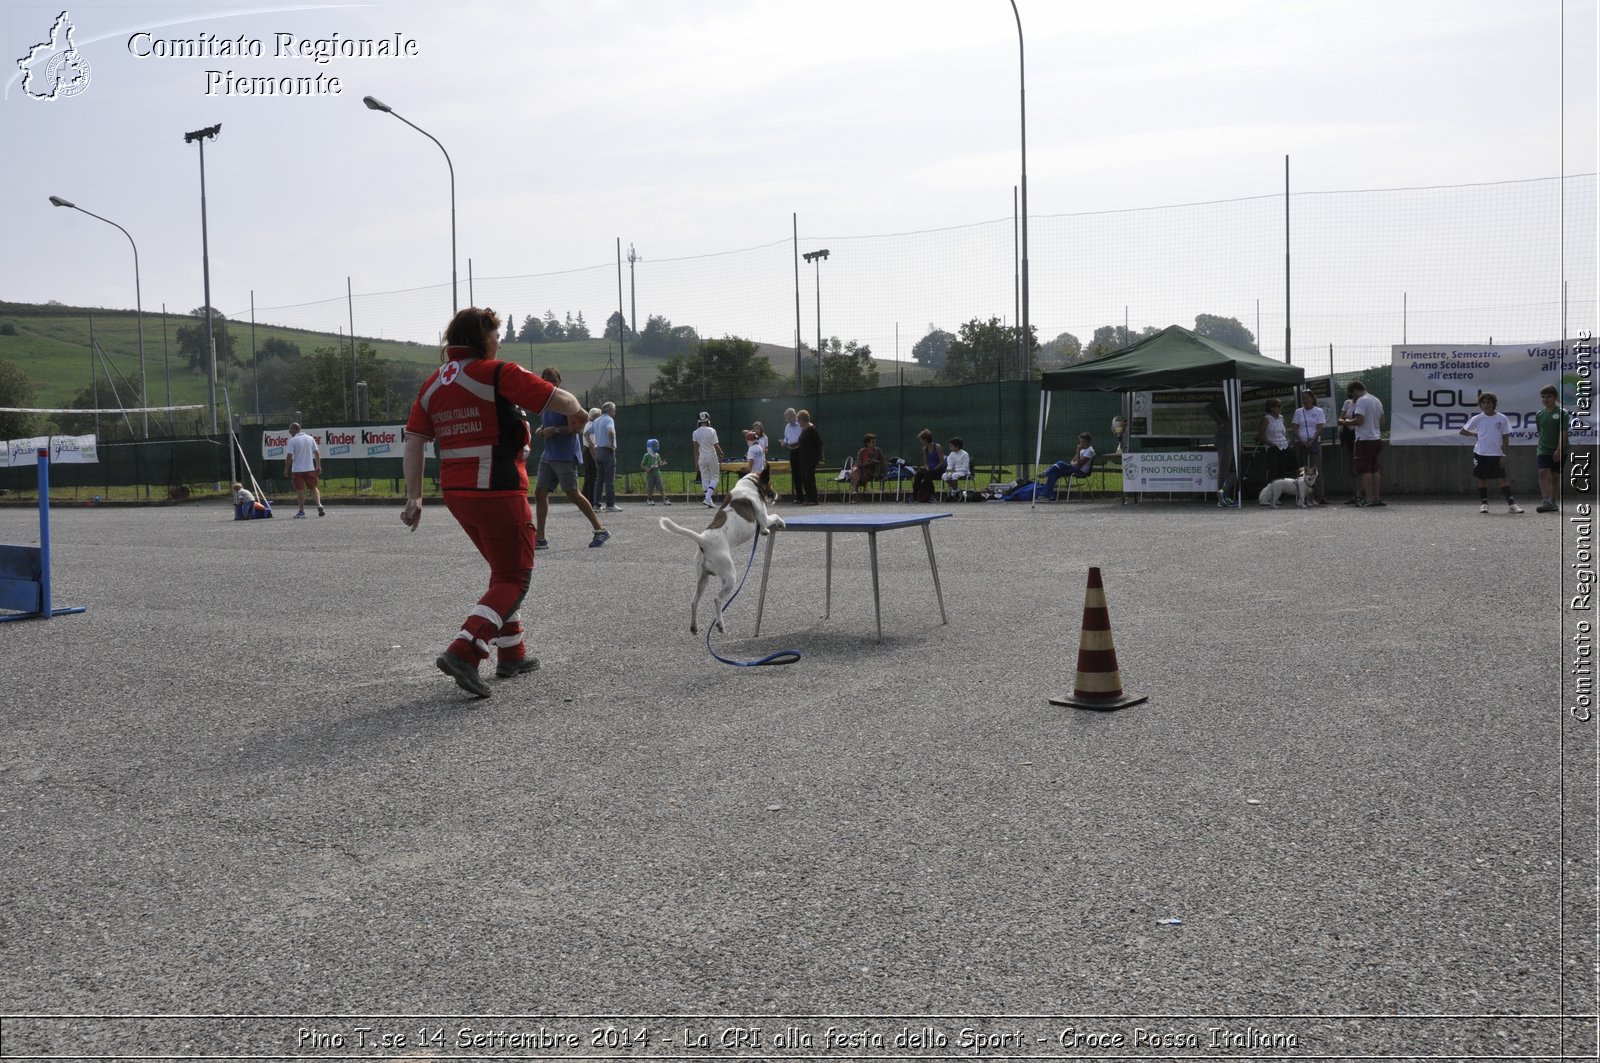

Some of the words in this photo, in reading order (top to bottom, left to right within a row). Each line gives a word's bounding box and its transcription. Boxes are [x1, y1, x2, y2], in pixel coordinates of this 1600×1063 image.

[1401, 351, 1449, 360] Trimestre,
[1451, 350, 1501, 359] Semestre,
[1527, 346, 1569, 359] Viaggi
[1410, 361, 1438, 370] Anno
[1440, 360, 1490, 369] Scolastico
[1428, 371, 1474, 380] all'estero
[1408, 389, 1482, 408] YOU
[453, 407, 480, 419] ITALIANA
[452, 421, 483, 435] SPECIALI
[1140, 454, 1172, 462] SCUOLA
[1173, 454, 1203, 462] CALCIO
[1141, 466, 1160, 474] PINO
[1163, 466, 1203, 474] TORINESE
